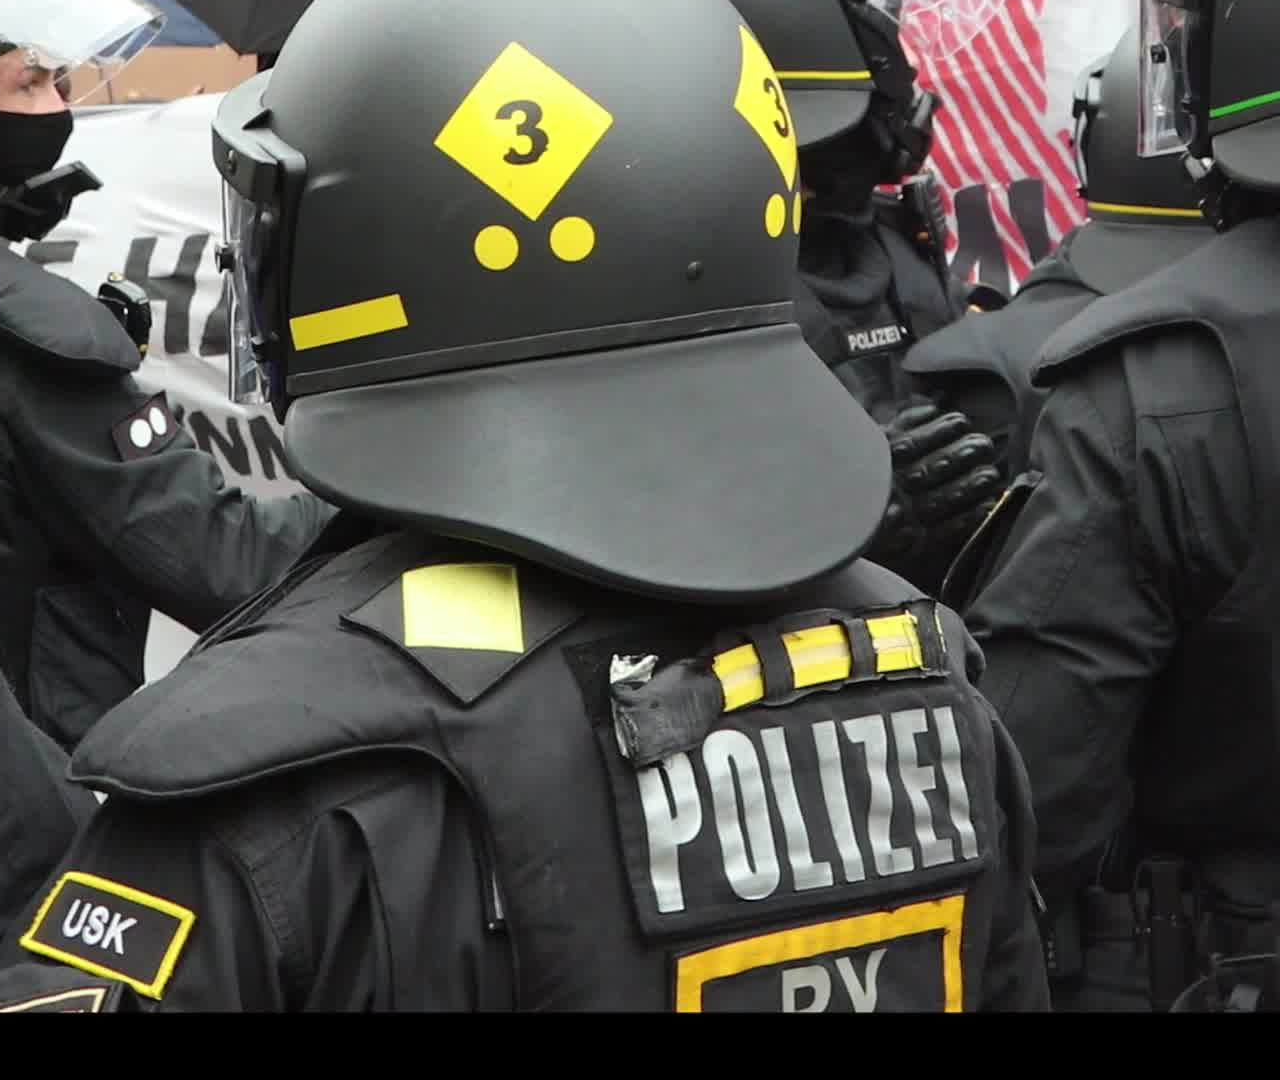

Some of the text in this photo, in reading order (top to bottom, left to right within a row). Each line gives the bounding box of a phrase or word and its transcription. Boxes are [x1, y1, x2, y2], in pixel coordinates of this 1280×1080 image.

[495, 99, 550, 165] 3
[847, 324, 902, 352] POLIZEI
[637, 706, 980, 914] POLIZEI
[62, 899, 137, 955] USK
